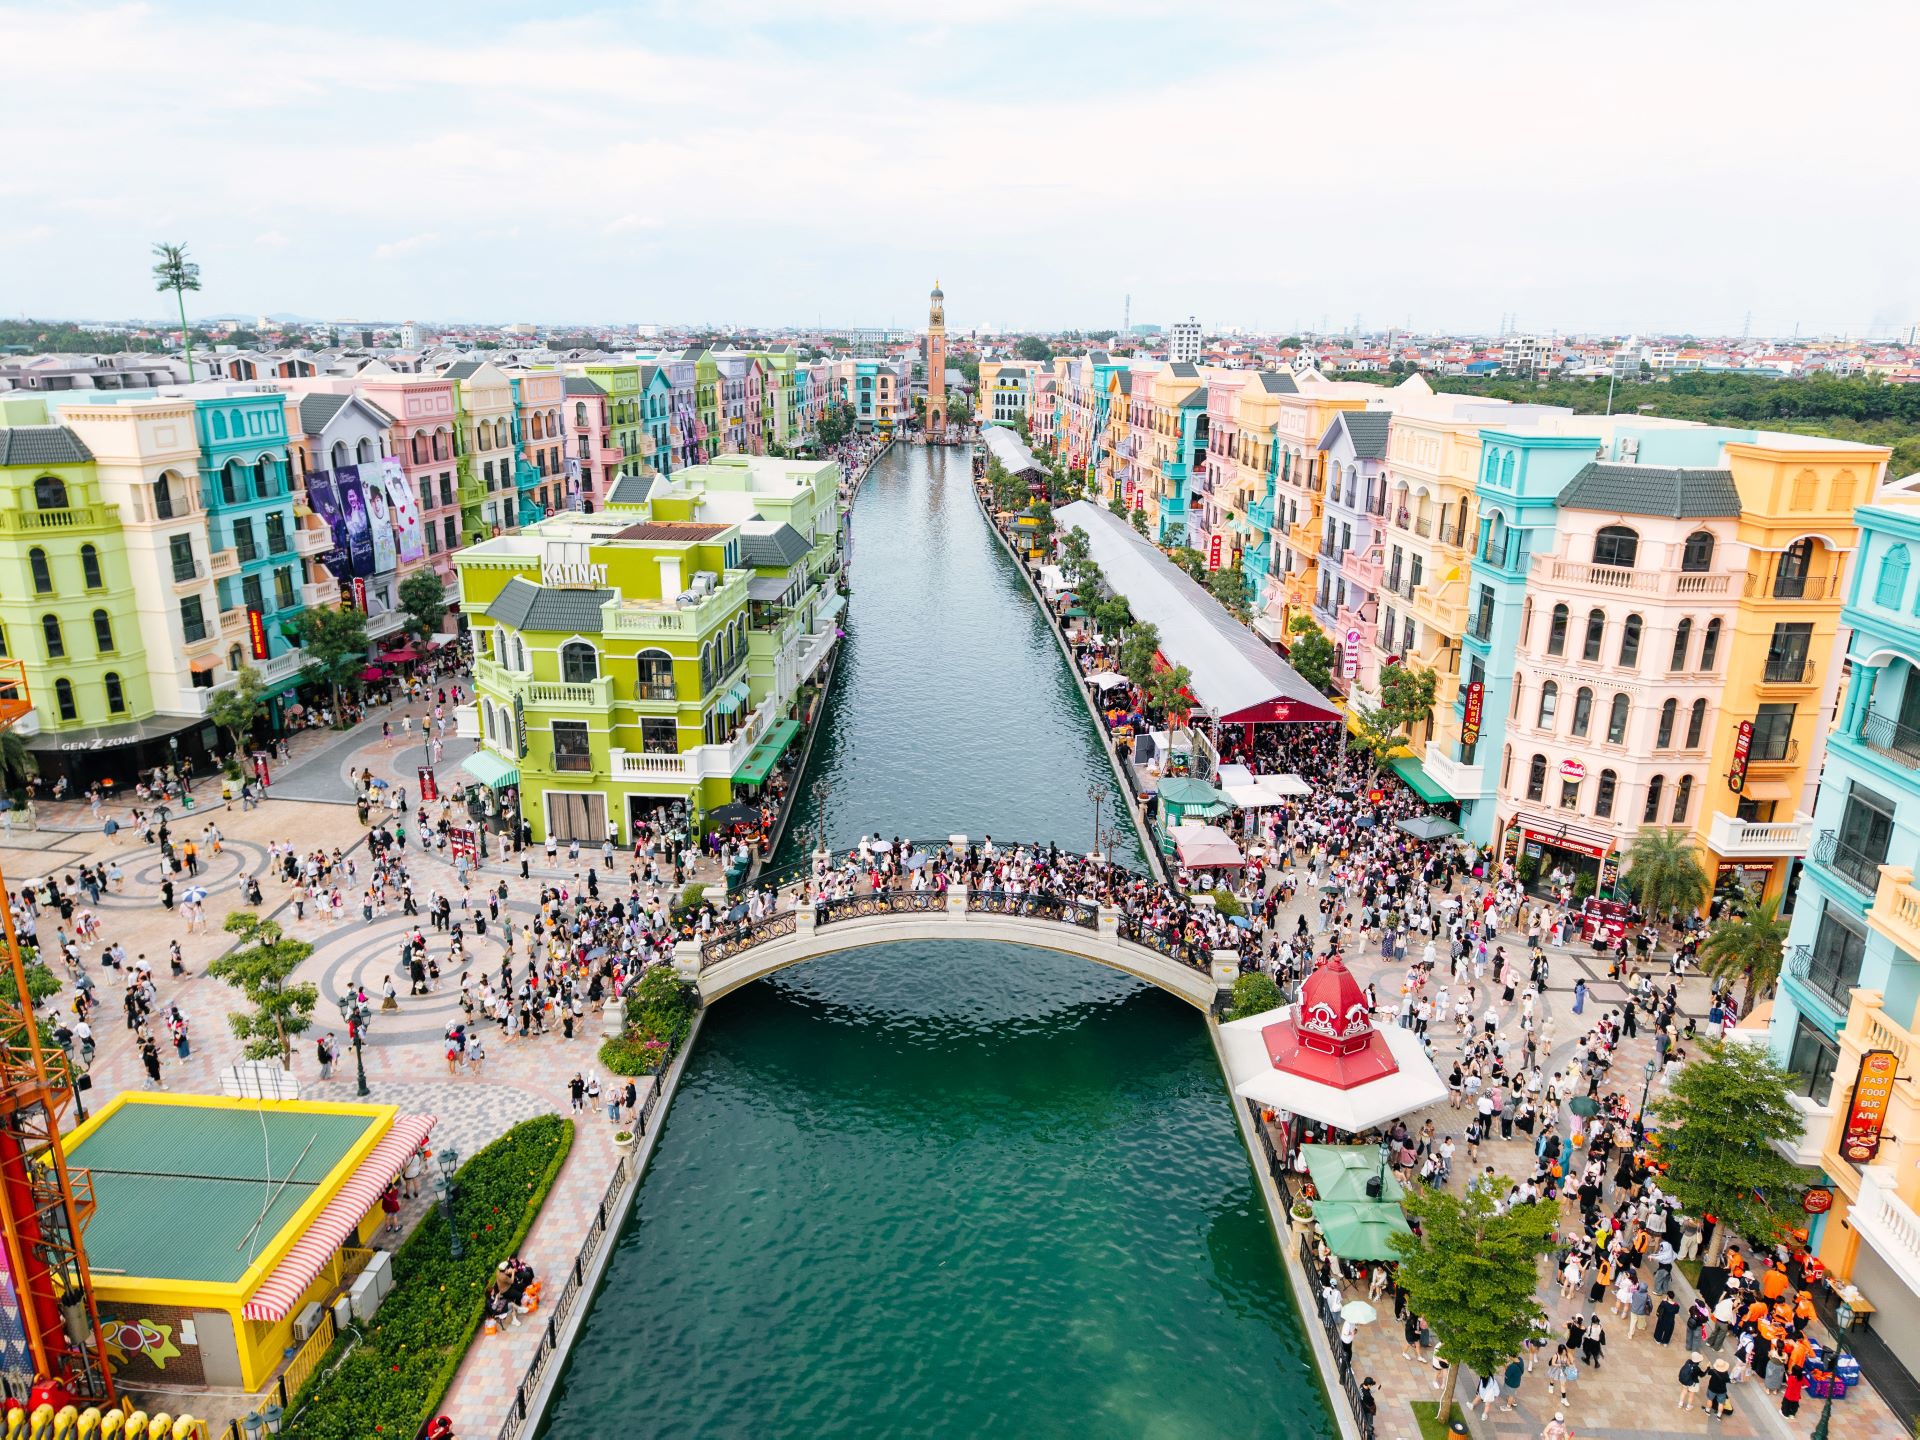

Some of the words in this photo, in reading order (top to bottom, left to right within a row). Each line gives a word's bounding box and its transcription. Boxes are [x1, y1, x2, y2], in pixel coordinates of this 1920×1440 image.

[541, 563, 608, 586] KATINAT
[1470, 693, 1479, 723] KOMBO
[519, 710, 527, 748] KATINAT
[61, 741, 88, 751] GEN
[90, 737, 104, 750] Z
[105, 734, 139, 747] ZONE
[1561, 841, 1594, 854] SINGAPORE
[1863, 1076, 1889, 1085] FAST
[1860, 1088, 1886, 1097] FOOD
[1856, 1112, 1878, 1120] ANH
